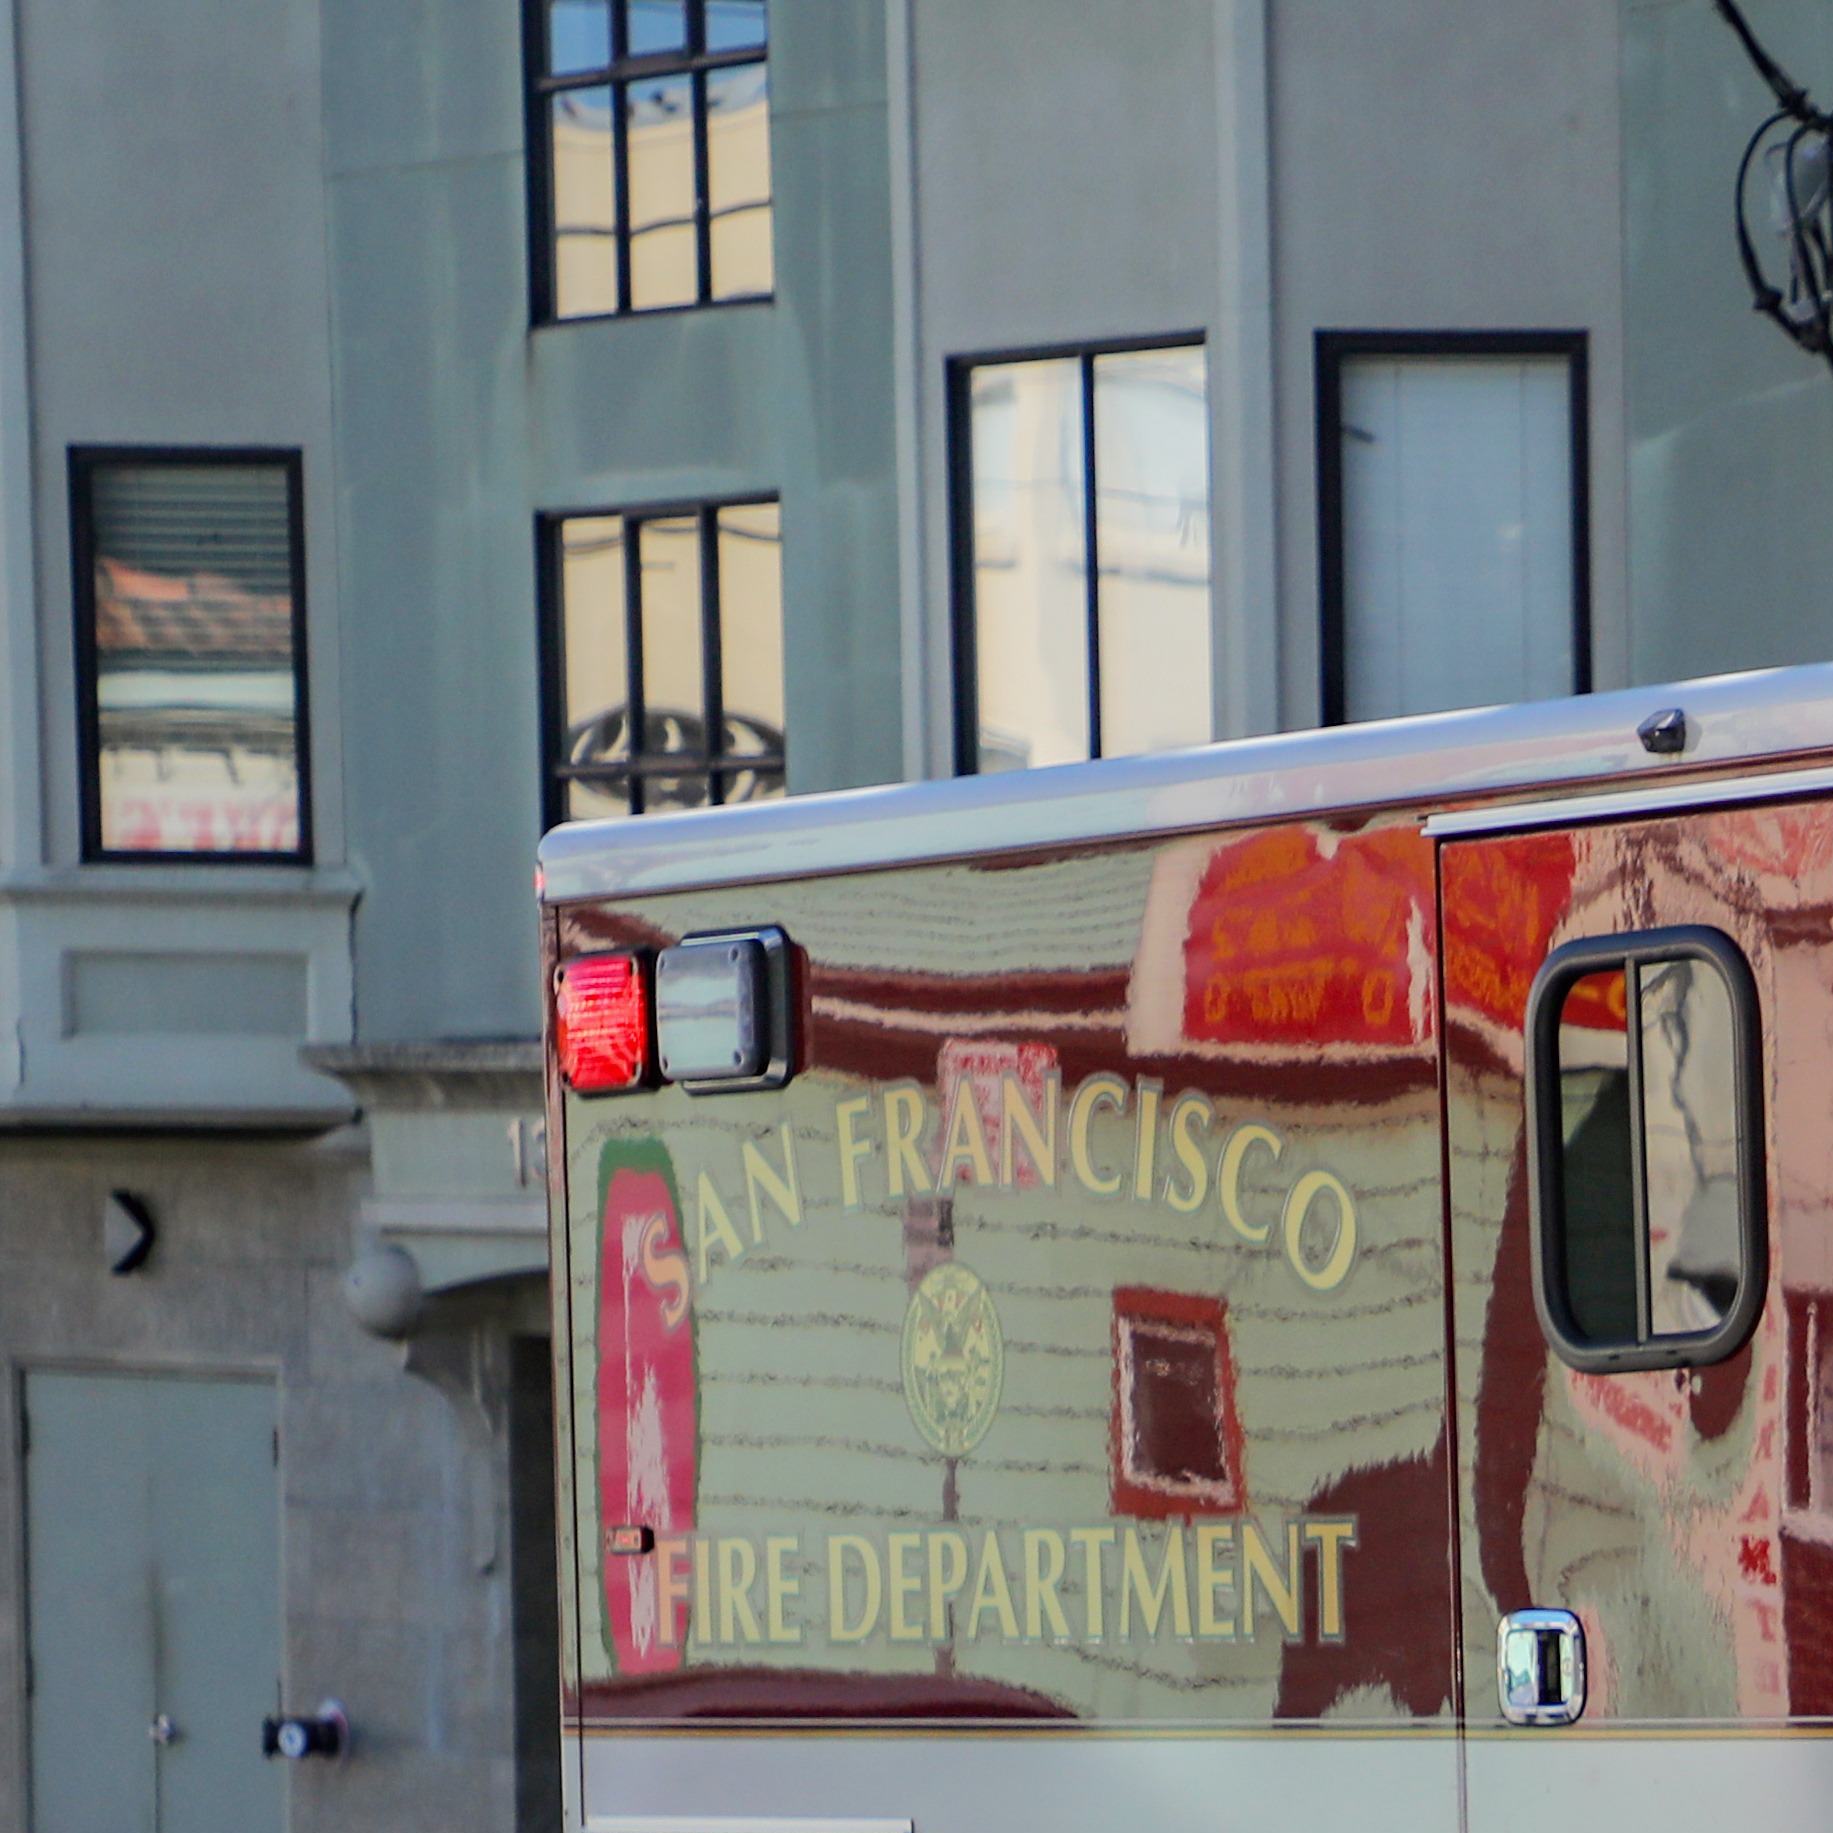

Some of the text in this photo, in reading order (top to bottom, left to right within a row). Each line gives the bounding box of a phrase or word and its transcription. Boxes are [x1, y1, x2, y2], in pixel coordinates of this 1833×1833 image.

[640, 1070, 1360, 1328] SAN FRANCISCO
[653, 1515, 1358, 1645] FIRE DEPARTMENT
